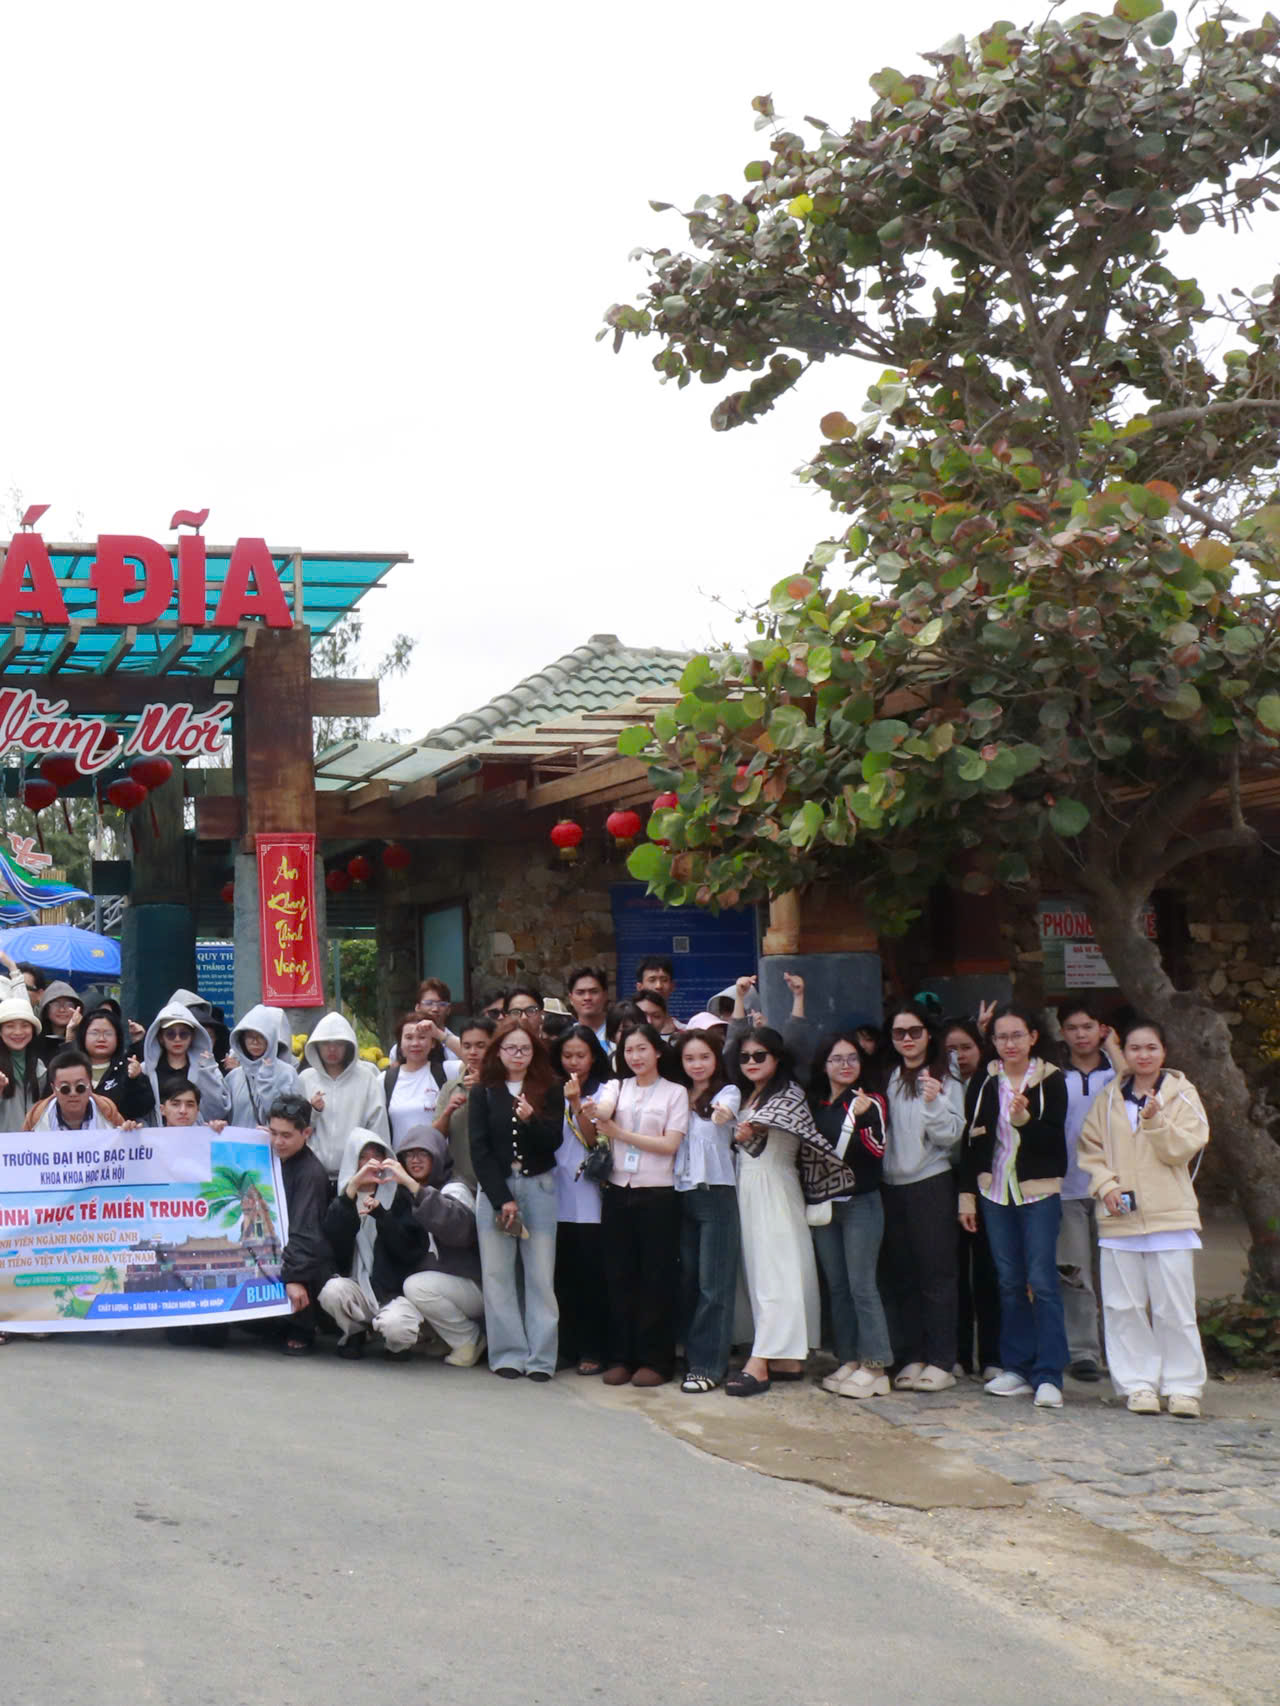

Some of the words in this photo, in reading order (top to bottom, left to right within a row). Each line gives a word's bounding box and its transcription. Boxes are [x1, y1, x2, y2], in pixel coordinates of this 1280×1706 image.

[90, 508, 294, 630] ĐĨA
[124, 701, 234, 756] Mới
[273, 856, 299, 885] An
[268, 891, 308, 921] Khang
[3, 1150, 49, 1167] TRƯỜNG
[53, 1151, 72, 1168] ĐẠI
[76, 1150, 100, 1167] HỌC
[104, 1148, 125, 1165] BẠC
[128, 1145, 153, 1161] LIÊU
[40, 1171, 61, 1185] KHOA
[63, 1170, 84, 1184] KHOA
[85, 1169, 99, 1184] HỌC
[112, 1166, 125, 1182] HỘI
[35, 1204, 75, 1226] THỰC
[79, 1198, 98, 1220] TẾ
[149, 1200, 208, 1218] TRUNG
[14, 1236, 34, 1247] VIÊN
[36, 1232, 67, 1245] NGÀNH
[70, 1231, 95, 1243] NGÔN
[97, 1230, 117, 1242] NGỮ
[119, 1232, 138, 1242] ANH
[8, 1253, 32, 1268] TIẾNG
[35, 1252, 53, 1267] VIỆT
[56, 1251, 69, 1265] VÀ
[71, 1251, 90, 1264] VĂN
[113, 1249, 133, 1263] VIỆT
[135, 1252, 155, 1263] NAM
